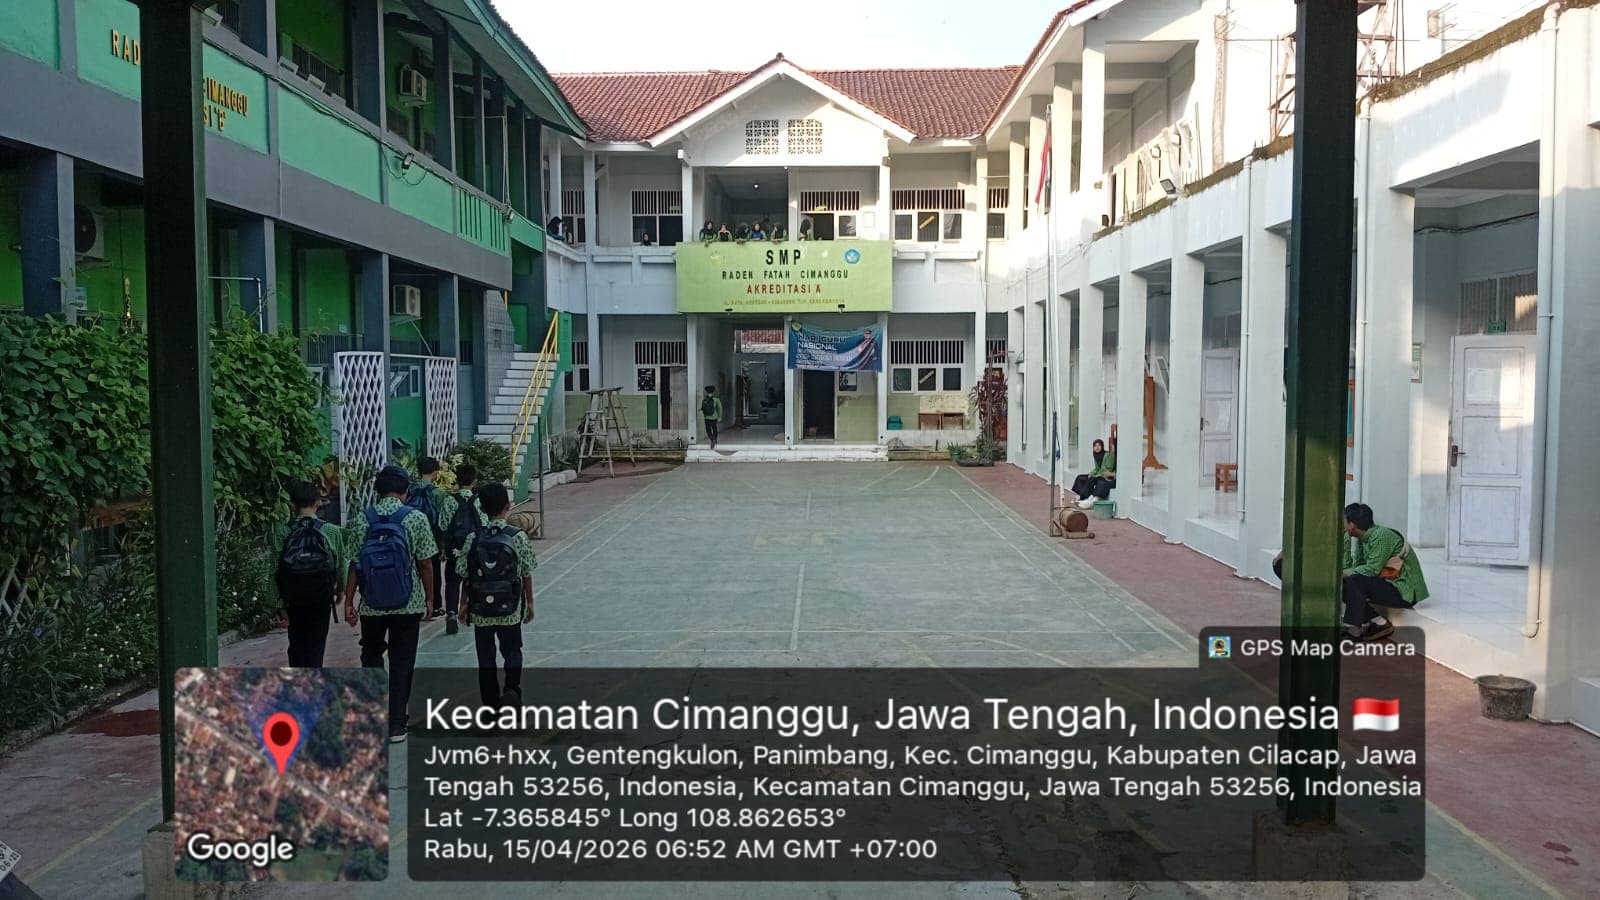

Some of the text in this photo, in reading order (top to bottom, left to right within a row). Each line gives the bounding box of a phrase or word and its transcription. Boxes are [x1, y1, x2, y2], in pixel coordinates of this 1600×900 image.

[766, 249, 801, 266] SMP
[722, 269, 849, 280] RADEN FATAH CIMANGGU
[747, 284, 821, 295] AKREDITASI A
[797, 341, 837, 352] NASIONAL
